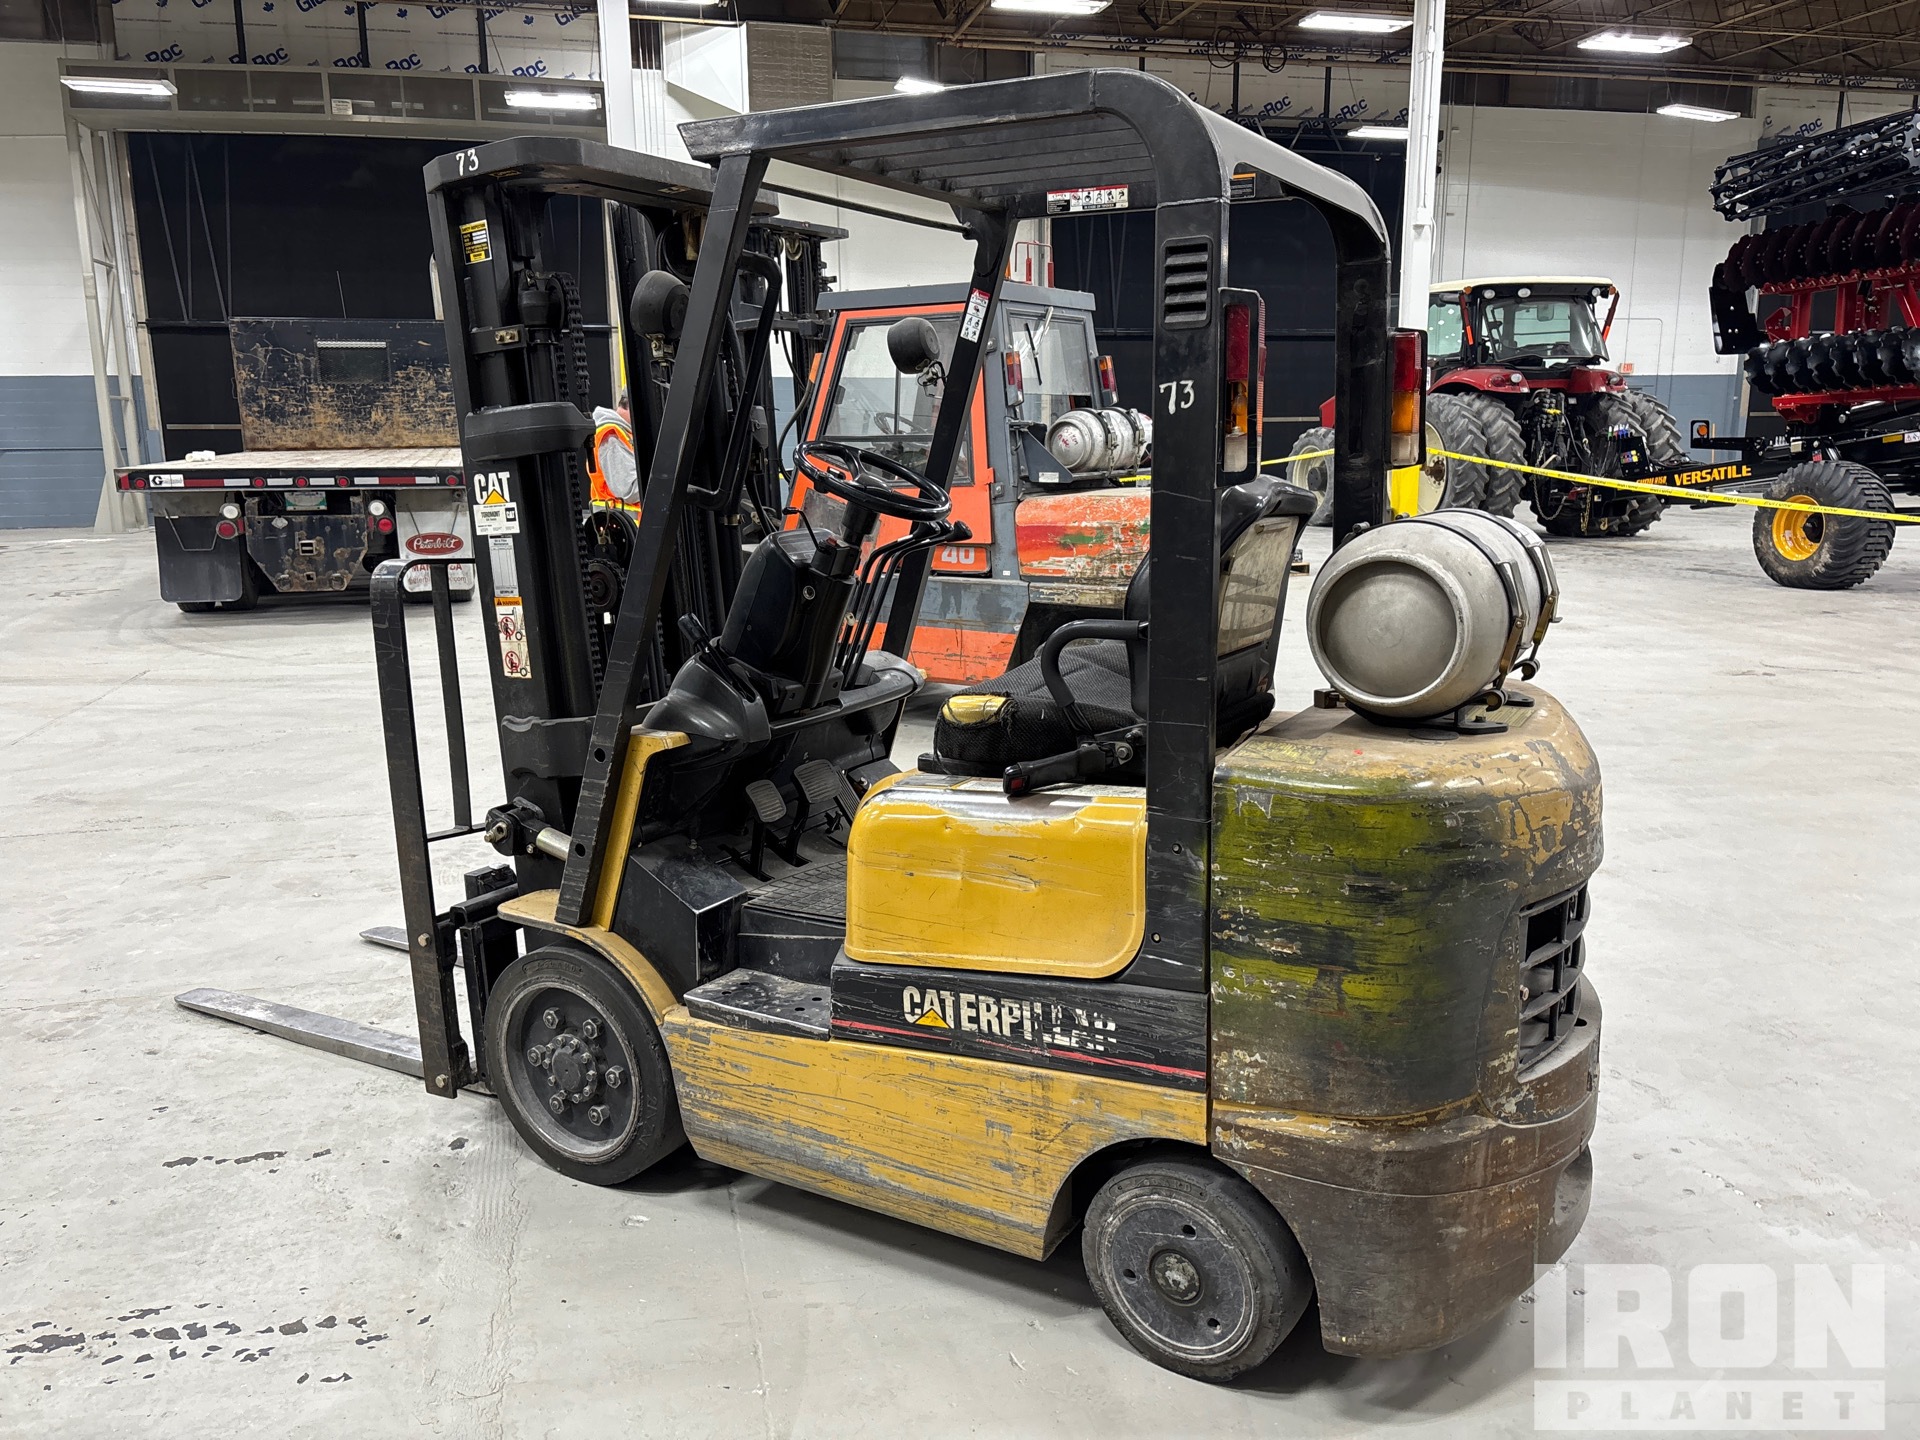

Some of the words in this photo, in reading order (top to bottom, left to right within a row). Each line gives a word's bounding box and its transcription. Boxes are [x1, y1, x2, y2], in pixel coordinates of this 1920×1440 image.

[455, 148, 479, 176] 73
[1158, 379, 1195, 415] 73
[1674, 465, 1752, 486] VERSATILE
[473, 471, 510, 505] CAT
[413, 537, 459, 551] Peterbilt
[941, 547, 975, 564] 40
